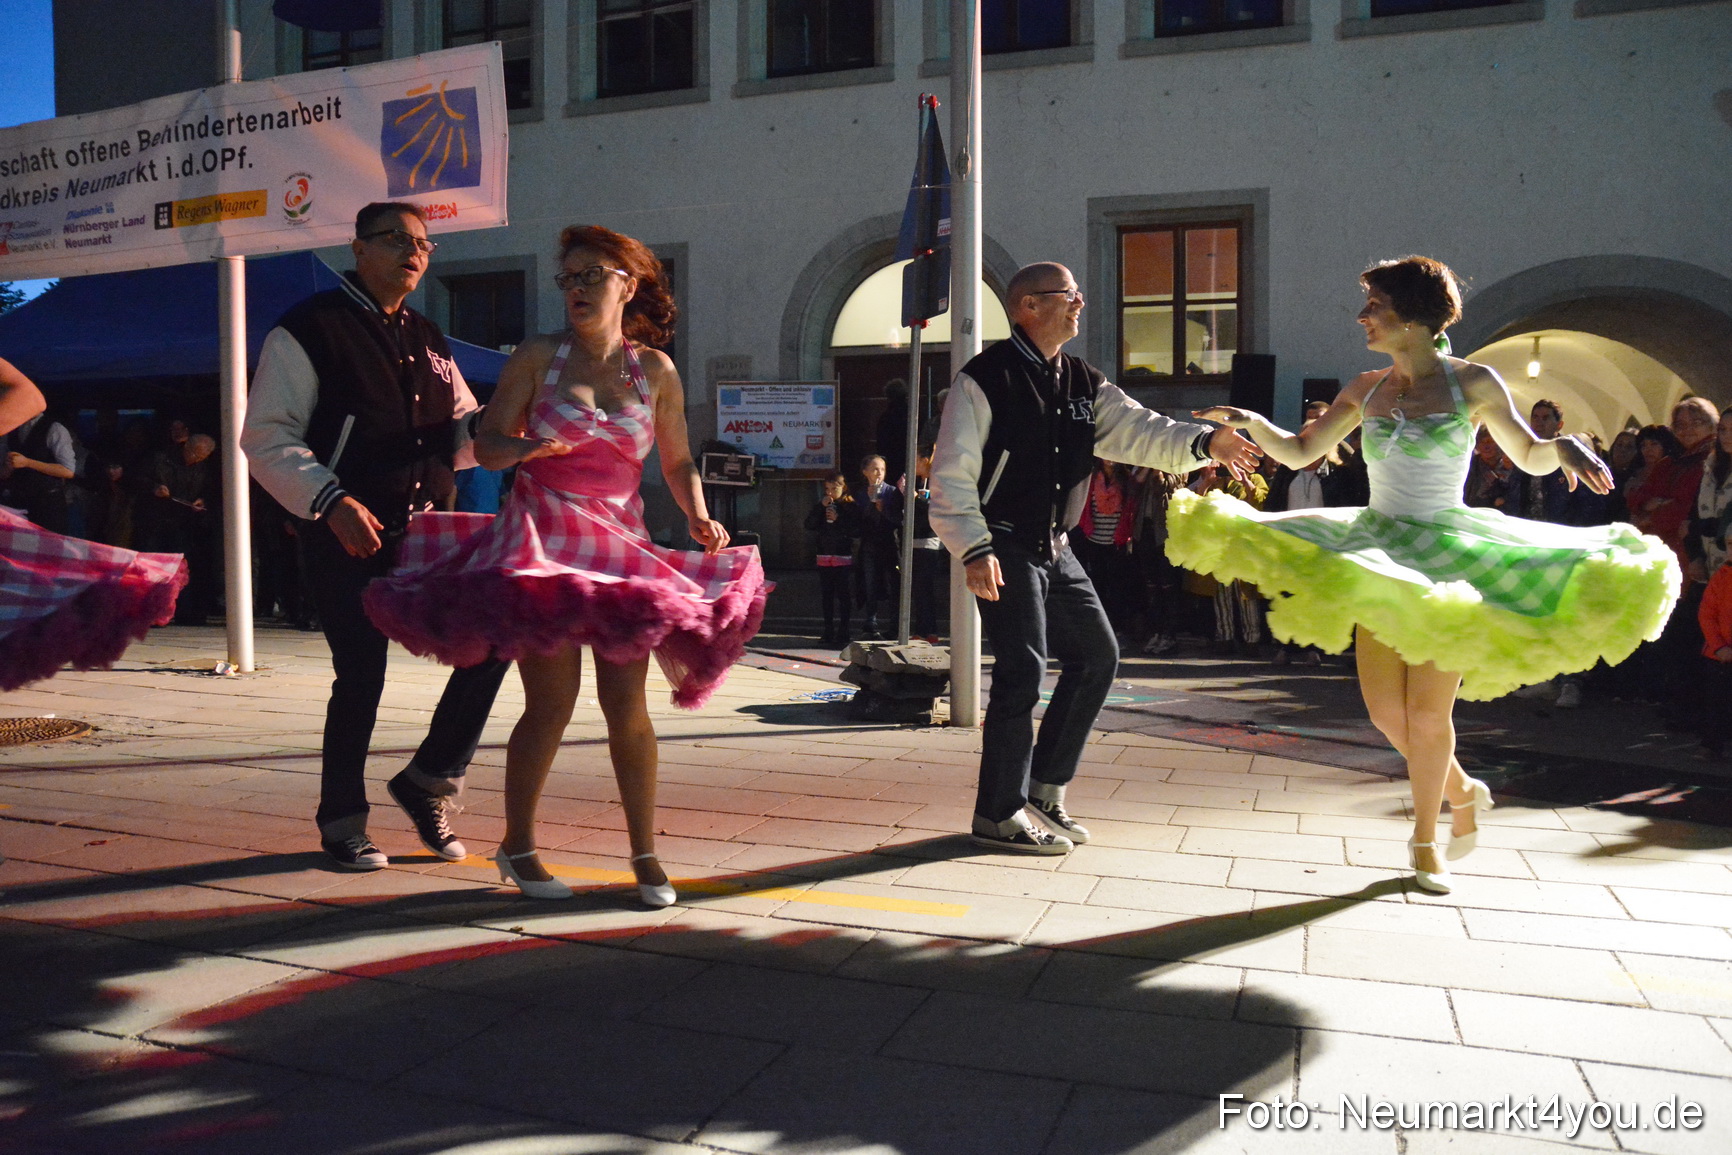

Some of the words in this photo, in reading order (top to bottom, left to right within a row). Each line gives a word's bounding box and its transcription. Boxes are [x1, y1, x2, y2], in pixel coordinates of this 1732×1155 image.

[0, 147, 58, 177] schaft
[65, 140, 131, 167] offene
[137, 96, 342, 152] Behindertenarbeit
[0, 182, 60, 210] dkreis
[65, 159, 158, 199] Neumarkt
[166, 145, 253, 179] i.d.OPf.
[177, 205, 212, 222] Regens
[214, 198, 259, 216] Wagner
[63, 219, 119, 234] Nürnberger
[122, 214, 146, 227] Land
[64, 234, 112, 249] Neumarkt
